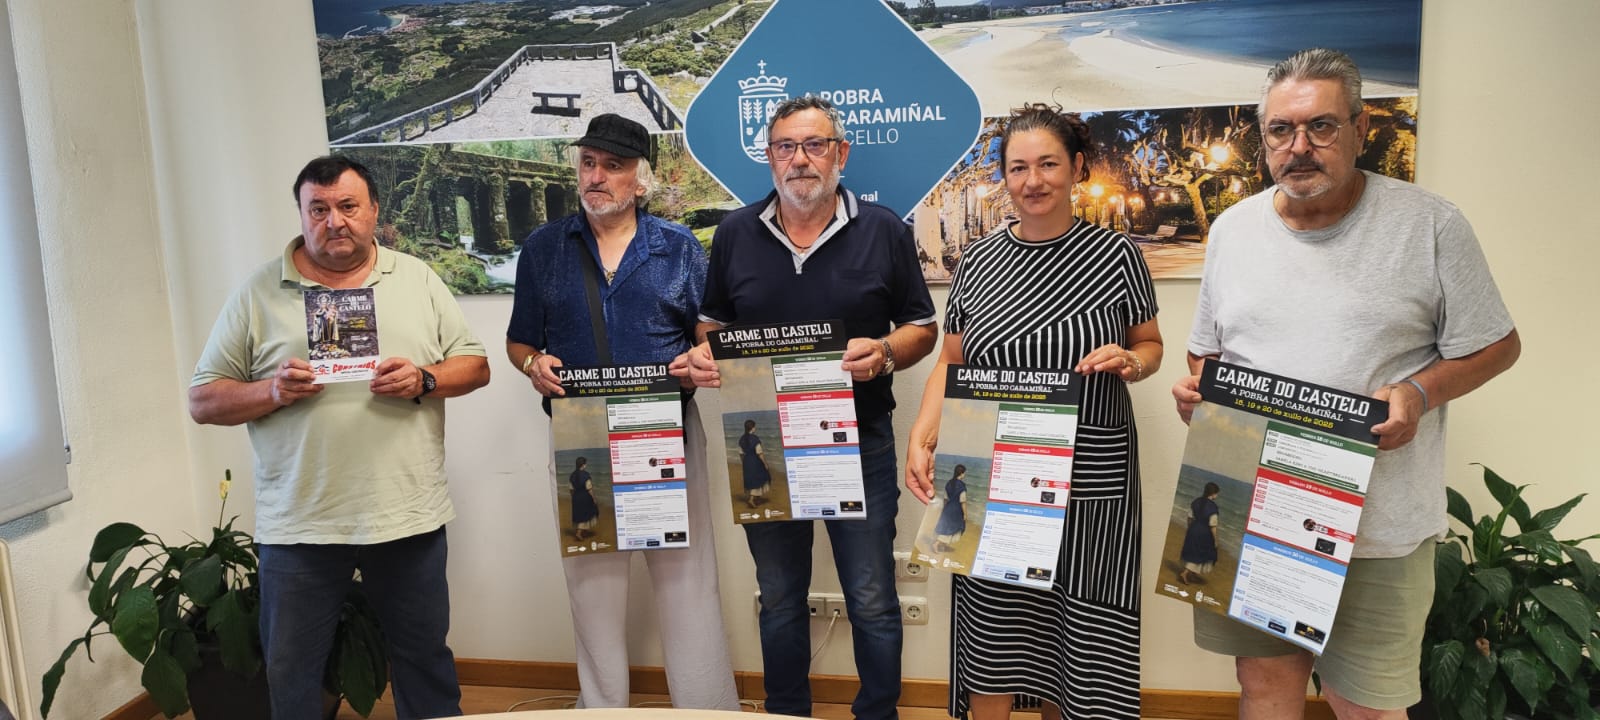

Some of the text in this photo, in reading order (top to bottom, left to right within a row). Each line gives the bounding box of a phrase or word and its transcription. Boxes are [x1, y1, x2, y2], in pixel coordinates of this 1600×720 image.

[820, 88, 884, 106] POBRA
[844, 128, 898, 145] CELLO
[719, 323, 832, 343] CARME DO CASTELO
[560, 365, 667, 382] CARME DO CASTELO
[957, 369, 1070, 385] CARME DO CASTELO
[1216, 366, 1370, 417] CARME DO CASTELO
[1239, 390, 1269, 403] POBRA
[1271, 397, 1284, 406] DO
[1313, 418, 1334, 428] 2025
